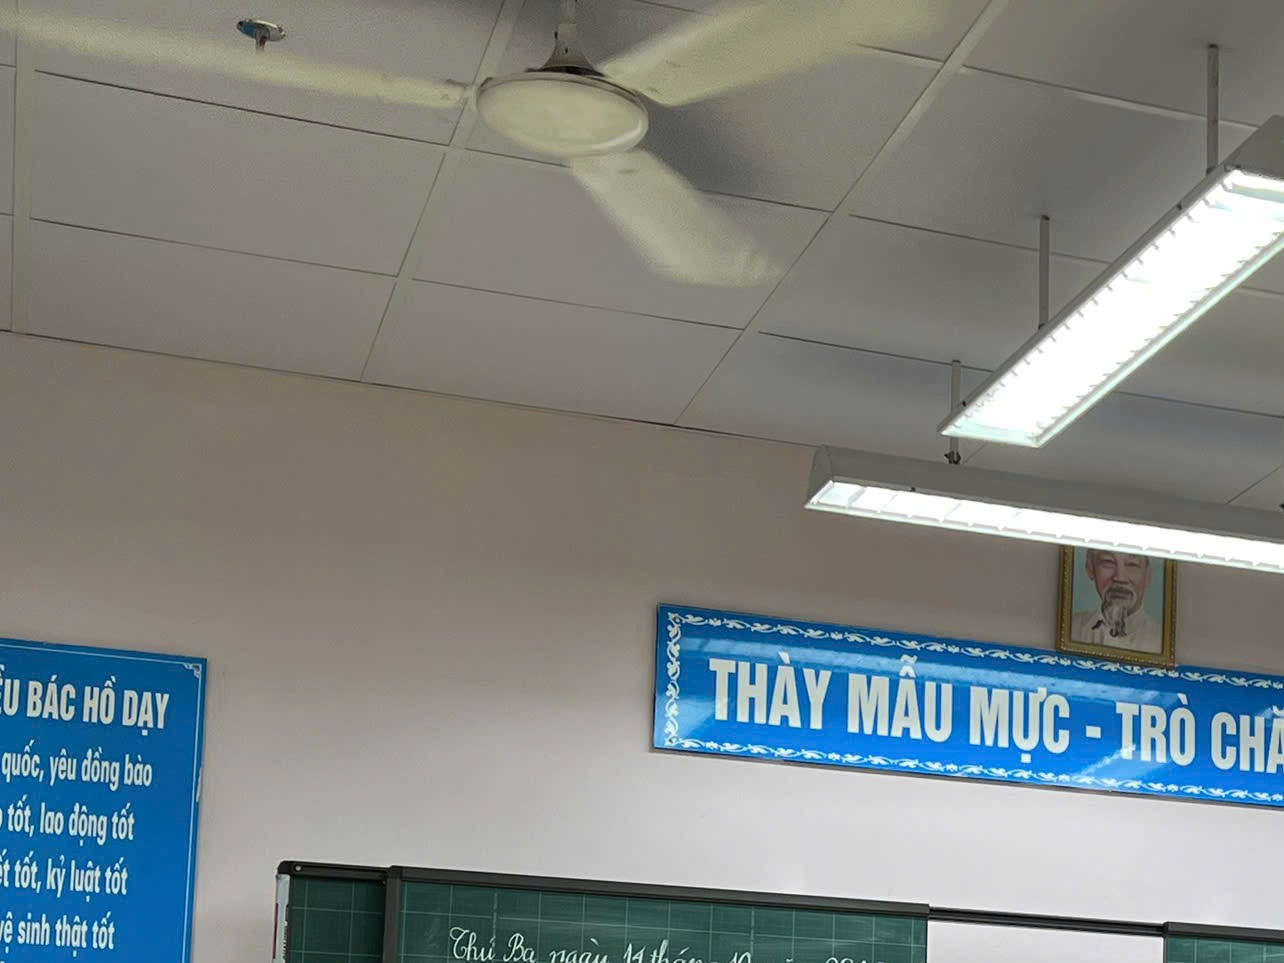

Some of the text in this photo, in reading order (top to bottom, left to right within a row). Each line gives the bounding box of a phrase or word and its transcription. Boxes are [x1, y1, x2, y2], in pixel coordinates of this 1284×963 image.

[27, 674, 76, 721] BÁC
[83, 675, 116, 725] HỒ
[122, 689, 170, 736] DẠY
[709, 651, 832, 730] THÀY
[848, 654, 953, 743] MẪU
[969, 686, 1071, 764] MỰC
[1116, 693, 1196, 767] TRÒ
[1, 739, 152, 792] quốc, yêu đồng bào
[7, 794, 35, 837] tốt,
[40, 802, 64, 835] lao
[68, 802, 108, 847] động
[112, 802, 135, 840] tốt
[14, 851, 41, 894] tốt,
[46, 855, 66, 898] kỷ
[70, 860, 101, 903] luật
[105, 857, 128, 895] tốt
[17, 912, 50, 946] sinh
[55, 915, 88, 957] thật
[92, 911, 115, 950] tốt
[450, 926, 497, 962] Thứ
[503, 933, 536, 963] Ba
